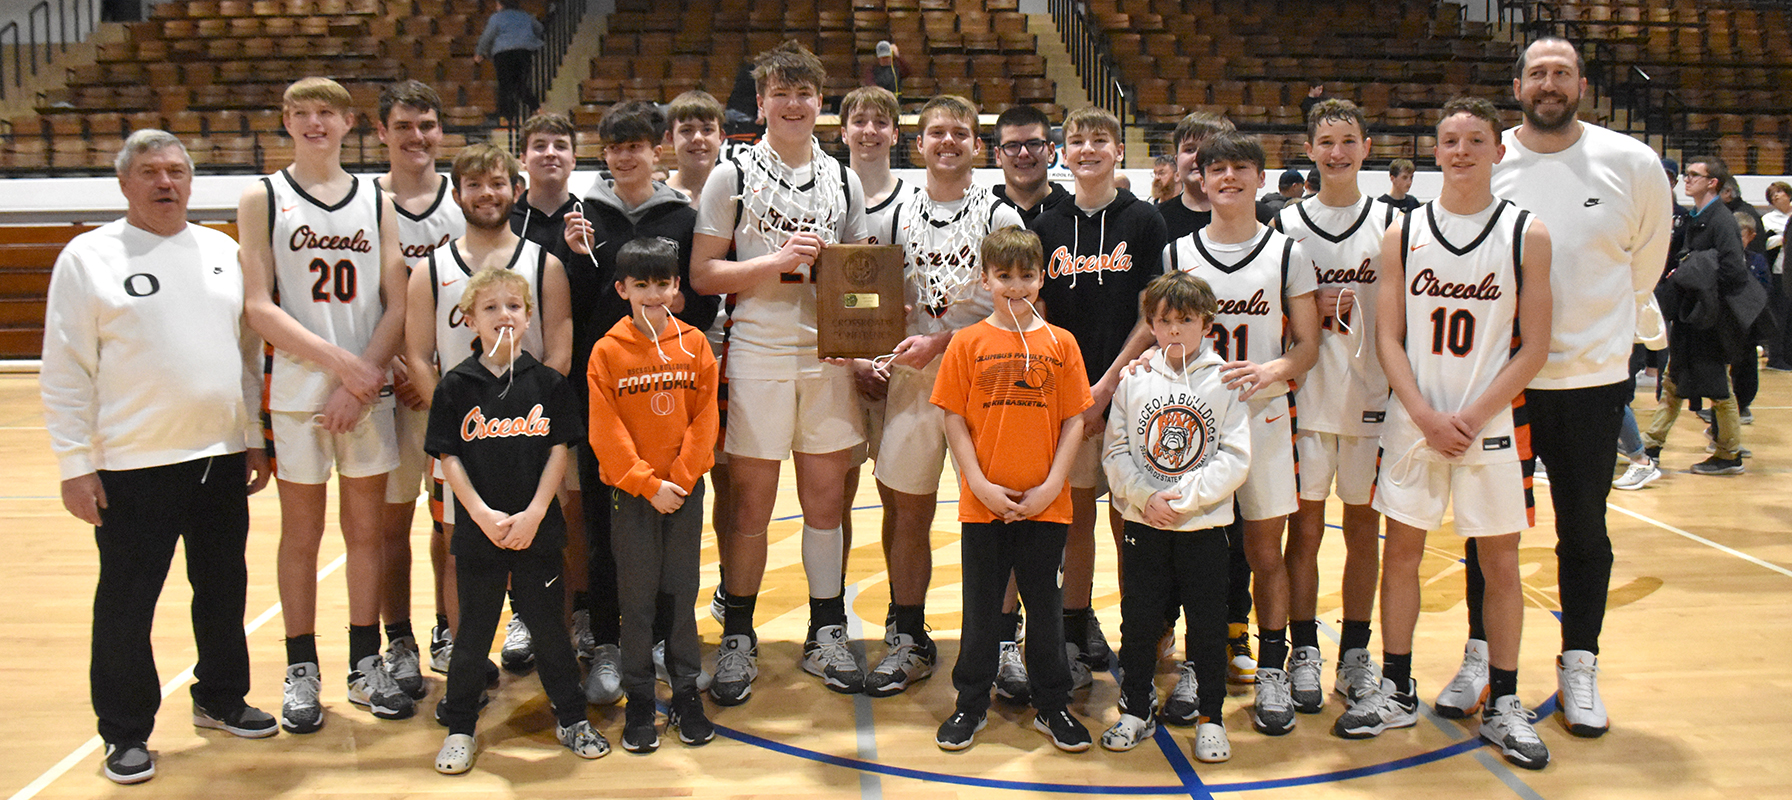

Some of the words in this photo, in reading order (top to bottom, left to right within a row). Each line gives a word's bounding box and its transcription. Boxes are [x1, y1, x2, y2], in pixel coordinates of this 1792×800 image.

[290, 225, 371, 253] Osceola
[1048, 241, 1133, 279] Osceola
[1312, 257, 1377, 284] sceola
[123, 272, 160, 297] O
[308, 257, 357, 303] 20
[1410, 267, 1502, 301] Osceola
[1214, 288, 1270, 316] ceola
[1430, 306, 1476, 358] 10
[975, 352, 1012, 363] OLUMBUS
[618, 371, 697, 397] FOOTBALL
[460, 403, 550, 442] Osceola
[1137, 394, 1175, 435] OSCEOLA
